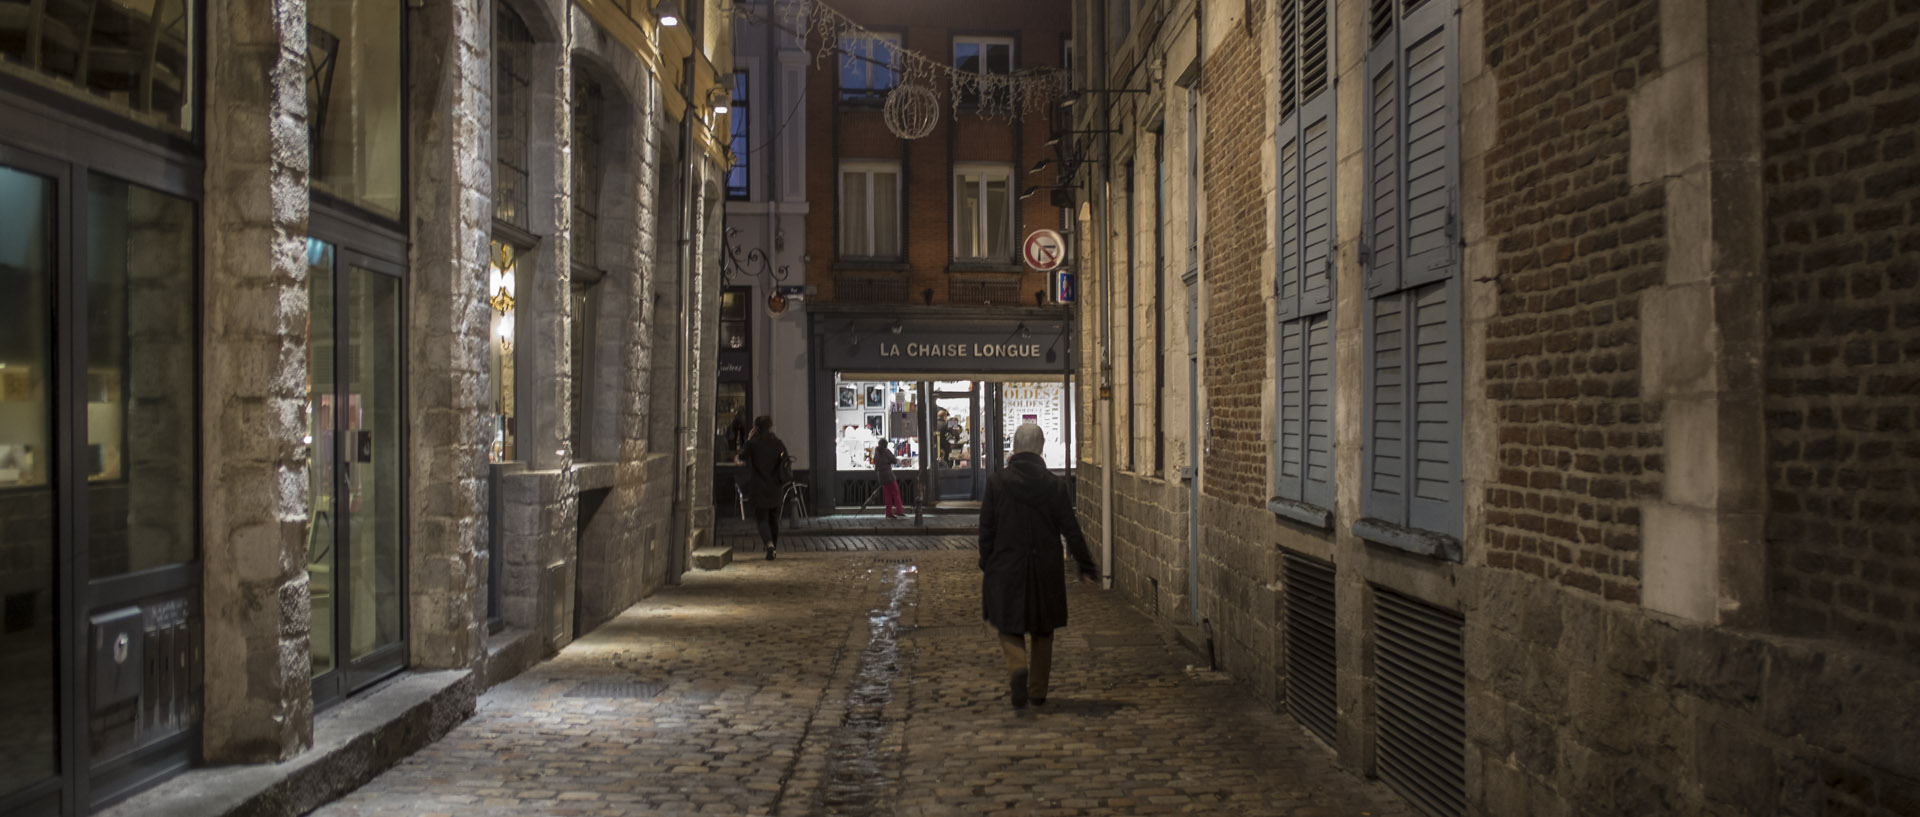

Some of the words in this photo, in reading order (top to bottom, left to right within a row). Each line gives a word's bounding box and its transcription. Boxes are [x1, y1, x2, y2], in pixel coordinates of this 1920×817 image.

[880, 342, 900, 357] LA
[906, 342, 968, 357] CHAISE
[973, 343, 1041, 358] LONGUE
[1004, 389, 1051, 399] OLDES
